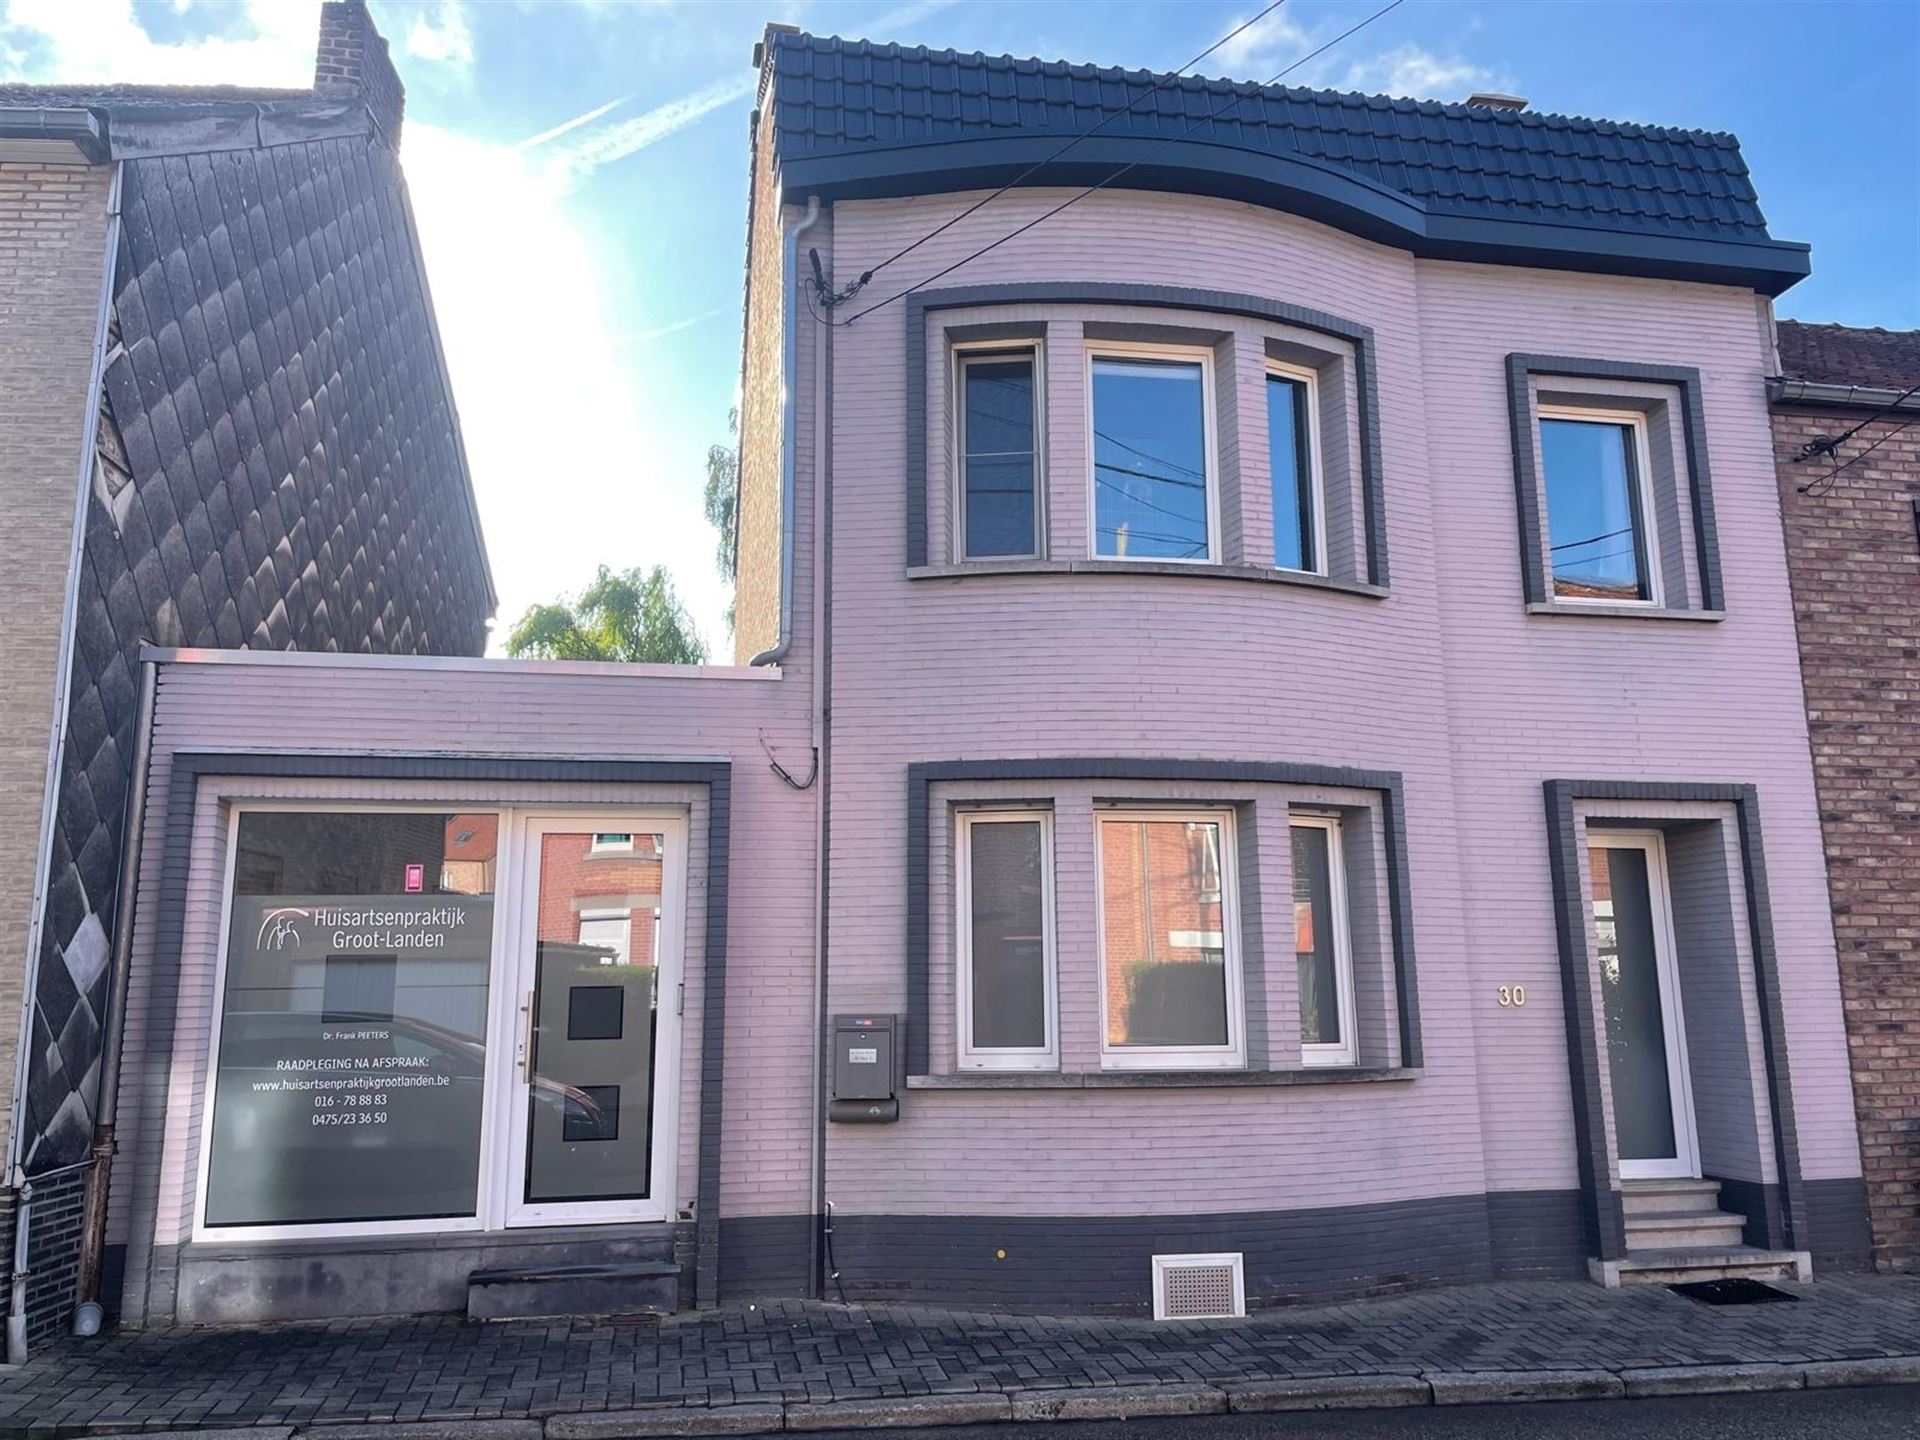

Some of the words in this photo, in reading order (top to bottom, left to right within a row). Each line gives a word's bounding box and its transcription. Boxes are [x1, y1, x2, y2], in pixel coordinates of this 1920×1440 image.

[314, 907, 466, 928] Huisartsenpraktijk
[332, 930, 444, 949] Groot-Landen
[1498, 985, 1525, 1007] 30
[323, 1032, 334, 1040] Dr.
[335, 1031, 356, 1040] Frank
[357, 1031, 389, 1040] PEETERS
[276, 1058, 352, 1071] RAADPLEGING
[354, 1058, 370, 1069] NA
[372, 1056, 430, 1069] AFSPRAAK:
[252, 1075, 450, 1091] www.huisartsenpraktijkgrootlanden.be
[314, 1096, 334, 1107] 016
[343, 1095, 357, 1107] 78
[358, 1094, 372, 1106] 88
[374, 1094, 388, 1106] 83
[312, 1113, 356, 1126] 0475/23
[358, 1113, 373, 1124] 36
[374, 1112, 388, 1124] 50
